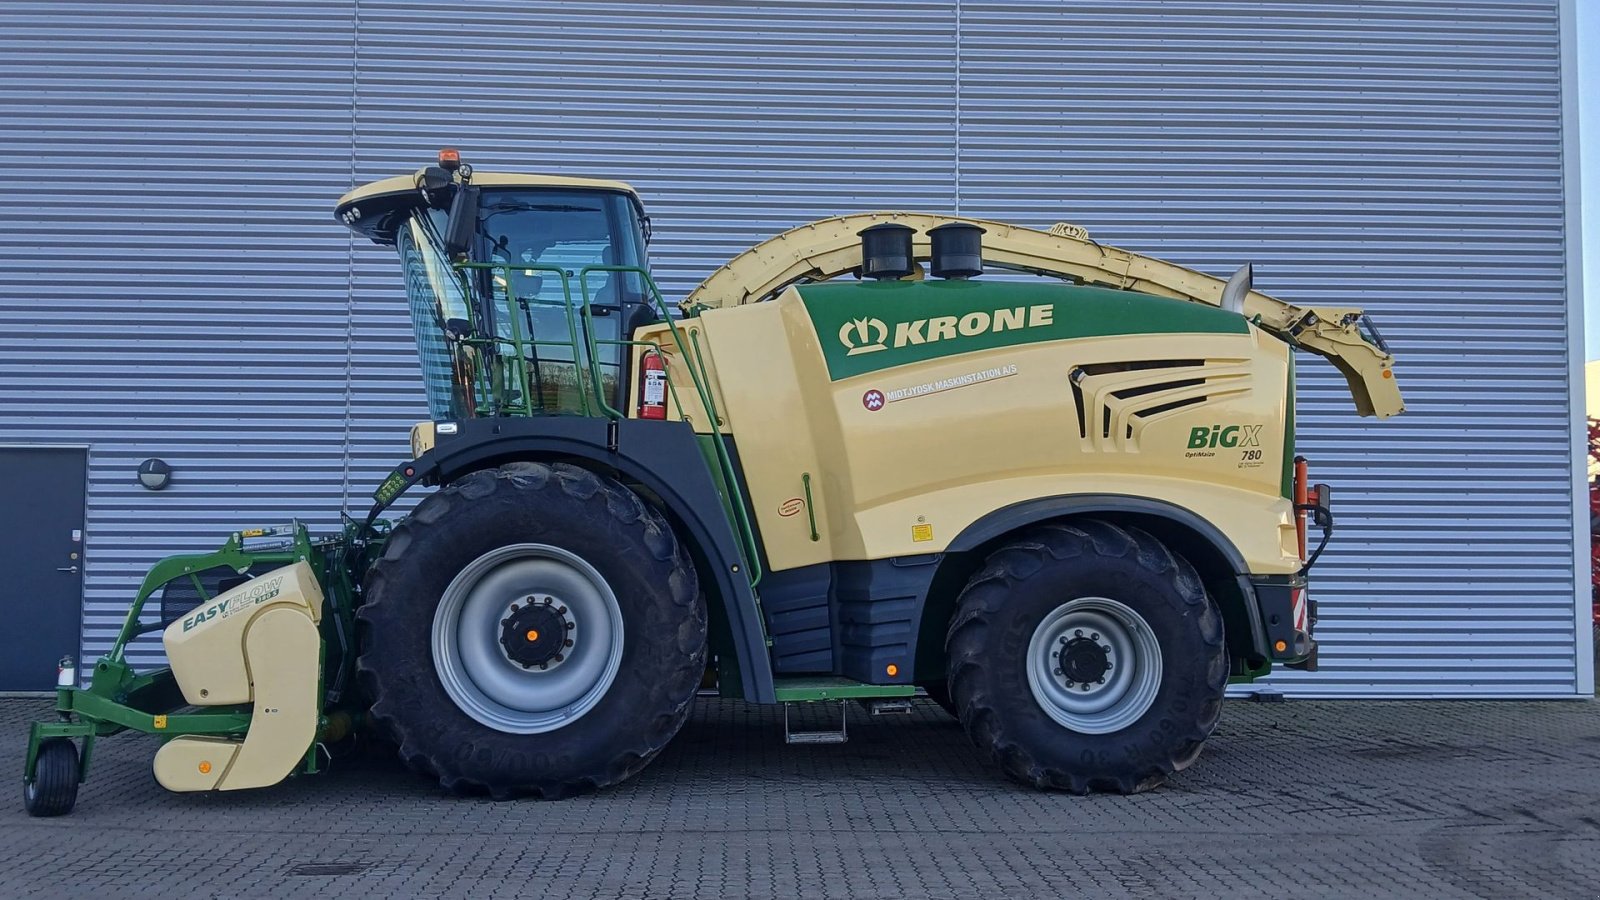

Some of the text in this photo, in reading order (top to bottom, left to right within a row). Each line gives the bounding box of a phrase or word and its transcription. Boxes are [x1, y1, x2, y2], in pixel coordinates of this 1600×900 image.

[893, 304, 1054, 348] KRONE
[886, 364, 1017, 400] MIDTJYDSK MASKINSTATION A/S
[1241, 450, 1262, 460] 780
[1080, 748, 1111, 766] 30
